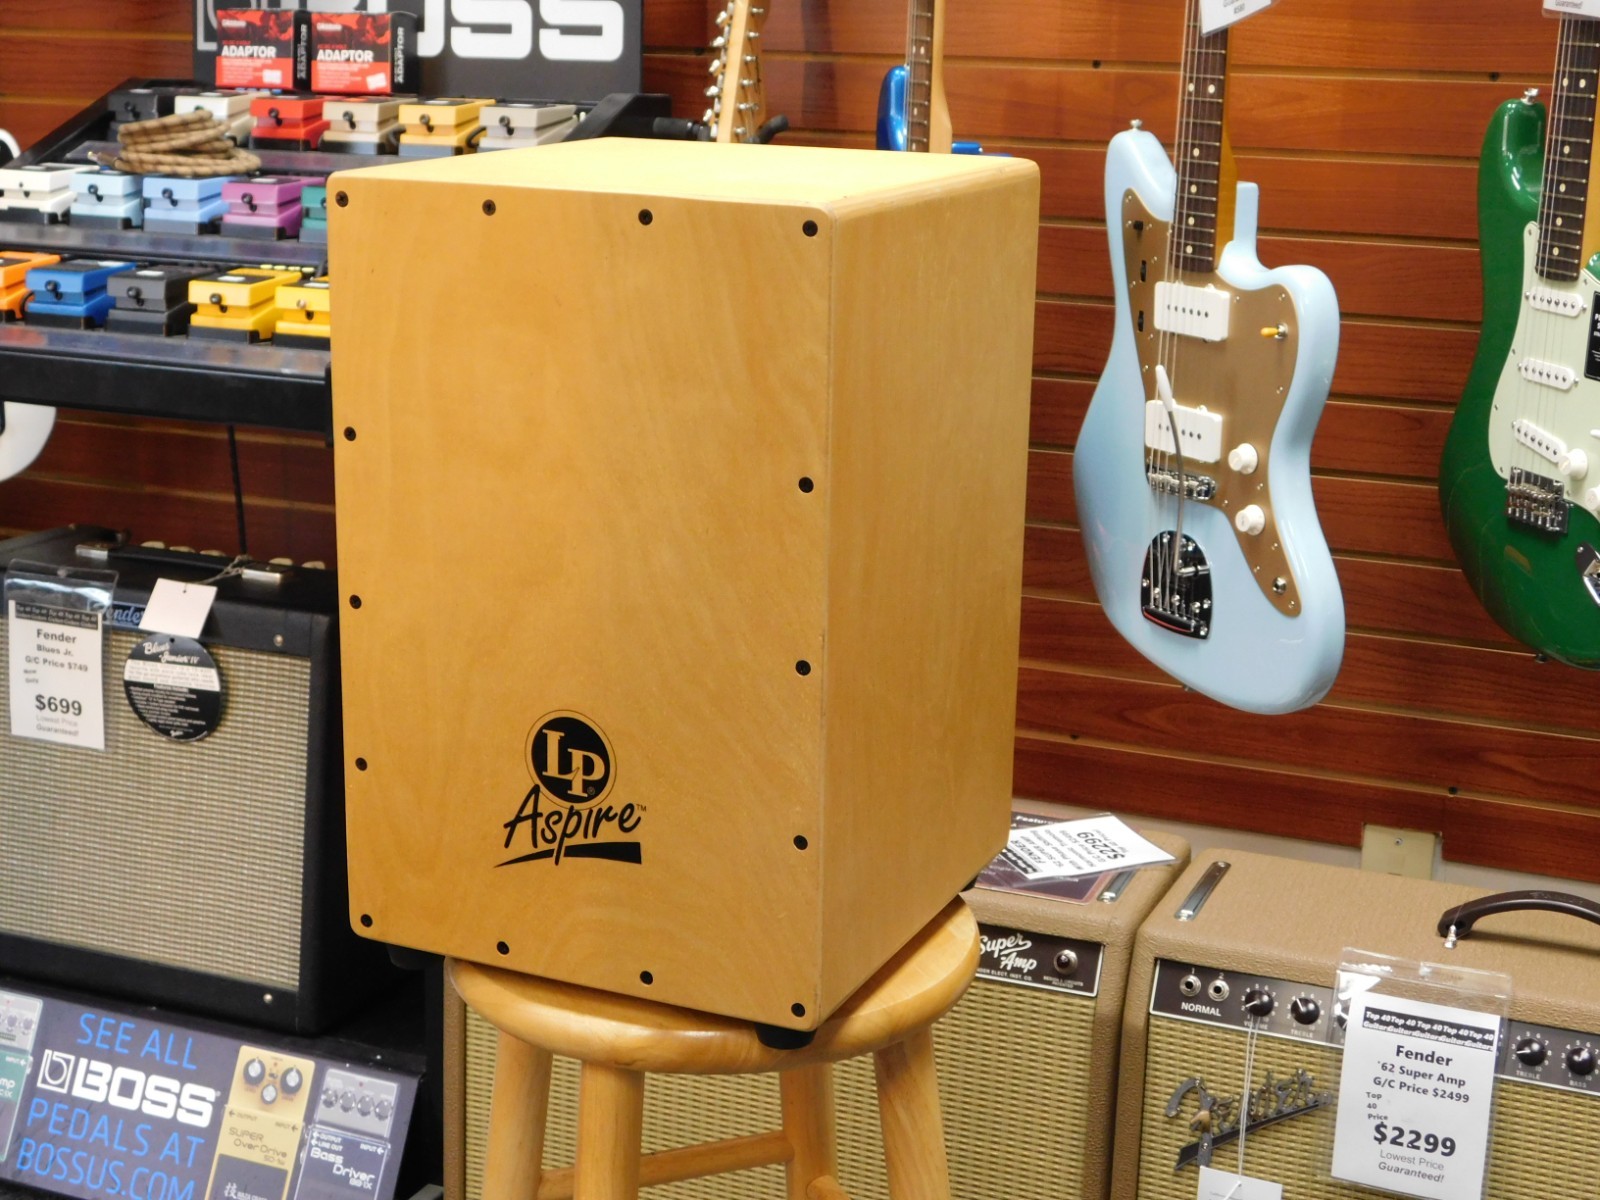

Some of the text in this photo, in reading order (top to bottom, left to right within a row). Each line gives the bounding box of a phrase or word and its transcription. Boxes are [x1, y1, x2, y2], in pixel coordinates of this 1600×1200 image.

[221, 45, 277, 59] ADAPTOR
[299, 24, 308, 79] ADAPTOR
[316, 50, 374, 62] ADAPTOR
[396, 27, 405, 83] ADAPTOR
[36, 628, 77, 644] Fender
[36, 644, 74, 657] Blues Jr.
[42, 658, 65, 669] Price
[67, 662, 88, 672] $749
[35, 694, 82, 717] $699
[542, 729, 606, 797] LP
[503, 784, 642, 866] Aspire
[1010, 840, 1046, 865] FENDER
[1076, 831, 1126, 860] $2299
[980, 933, 1032, 958] Super
[1000, 952, 1037, 973] Amp
[1181, 1002, 1221, 1017] NORMAL
[77, 1013, 197, 1070] SEE ALL
[1396, 1044, 1453, 1067] Fender
[1399, 1065, 1434, 1080] Super
[1437, 1073, 1466, 1088] Amp
[1516, 1070, 1540, 1080] TREBLE
[71, 1057, 216, 1129] BOSS
[1365, 1091, 1382, 1100] Top
[1373, 1076, 1470, 1103] G/C Price $2499
[1367, 1113, 1388, 1121] Price
[27, 1097, 205, 1168] PEDALS AT
[228, 1126, 264, 1142] SUPER
[1373, 1121, 1456, 1157] $2299
[310, 1147, 344, 1164] Bass
[1380, 1149, 1444, 1171] Lowest Price
[16, 1137, 195, 1200] BOSSUS.COM
[332, 1163, 376, 1183] Driver
[1378, 1161, 1445, 1183] Guaranteed!
